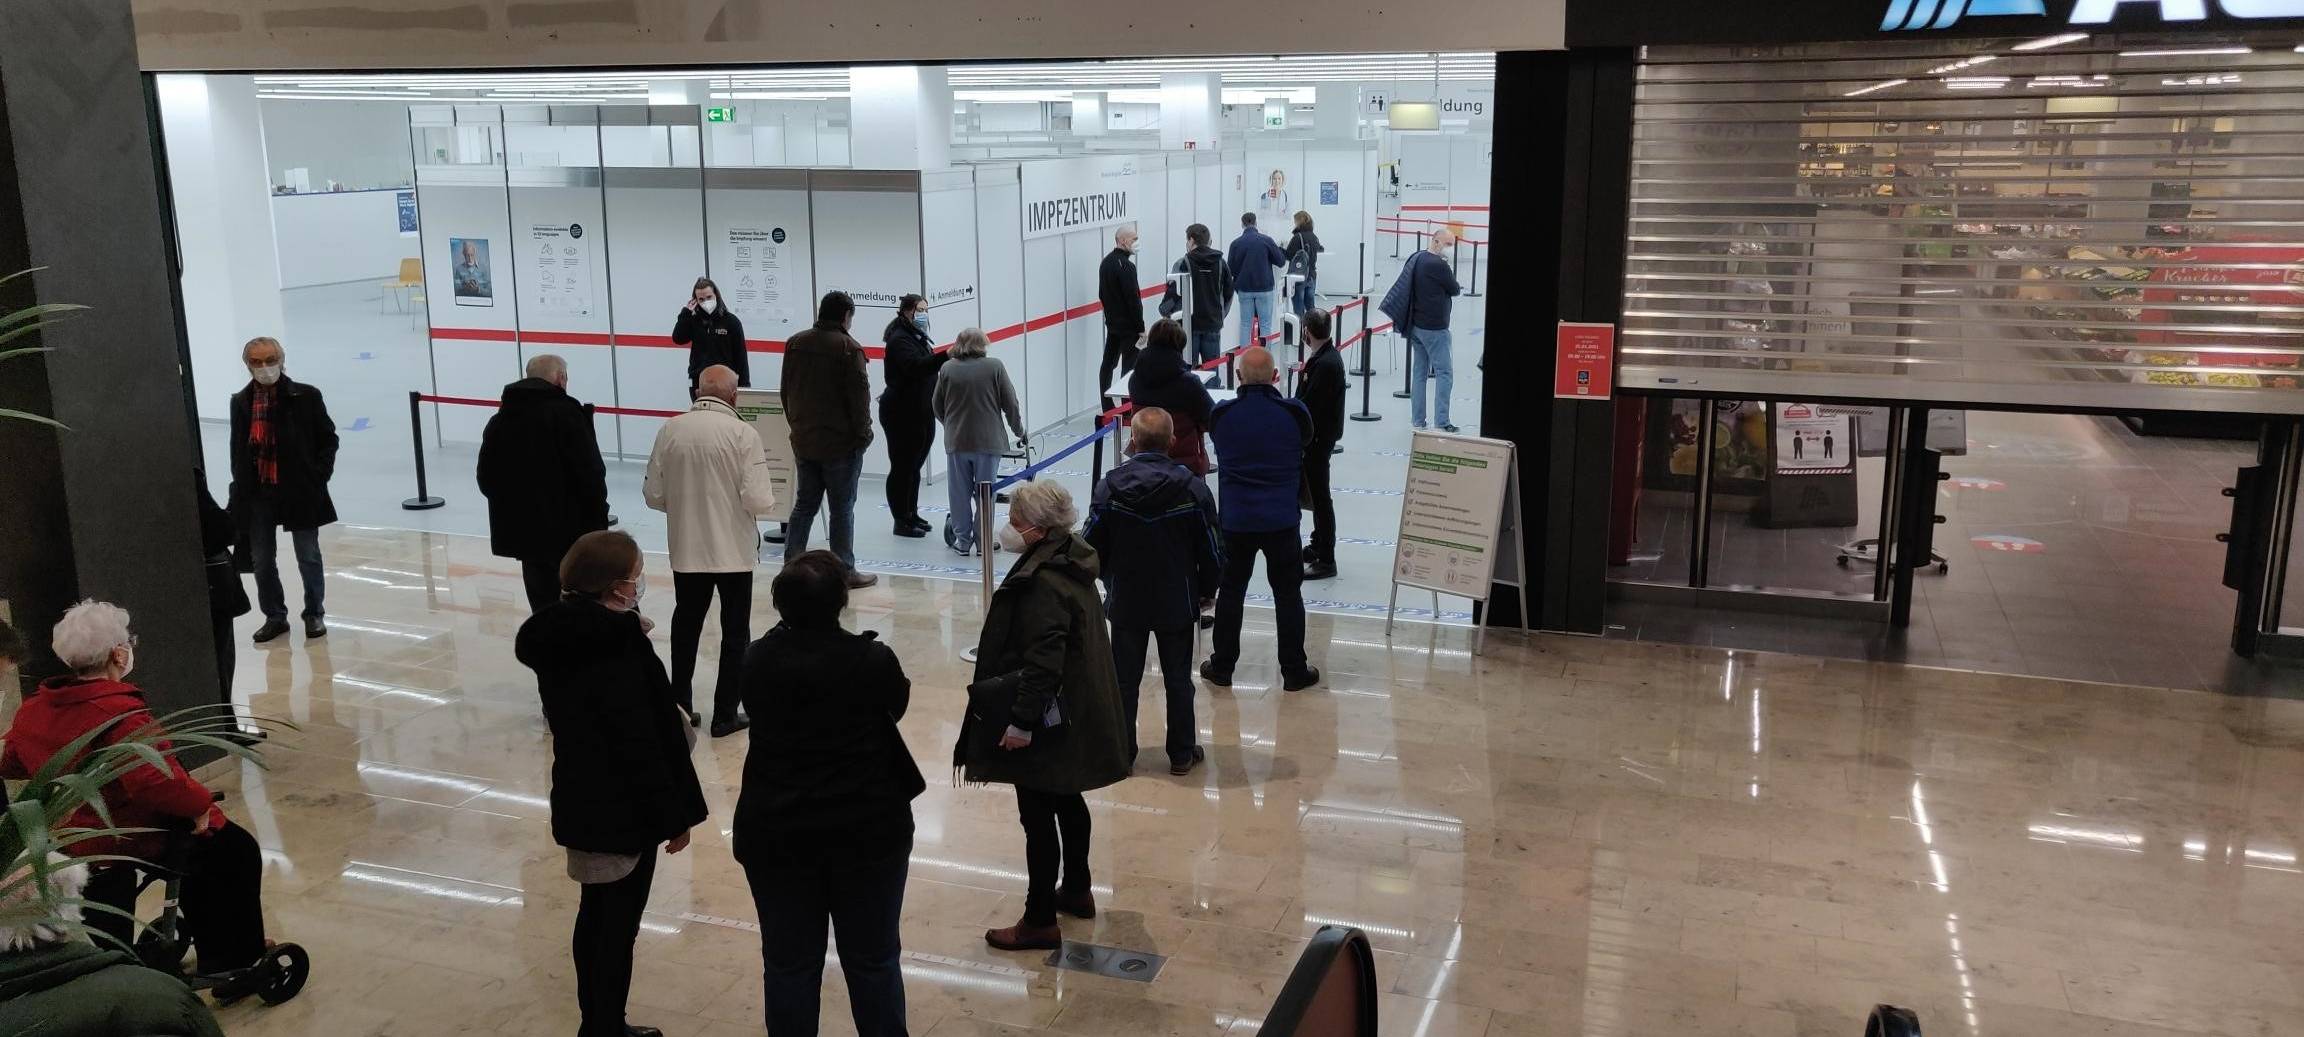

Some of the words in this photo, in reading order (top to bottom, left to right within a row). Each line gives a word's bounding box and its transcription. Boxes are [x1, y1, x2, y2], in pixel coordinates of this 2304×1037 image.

[1439, 98, 1484, 116] ldung
[1028, 191, 1127, 233] IMPFZENTRUM
[937, 287, 966, 301] Anmeldung
